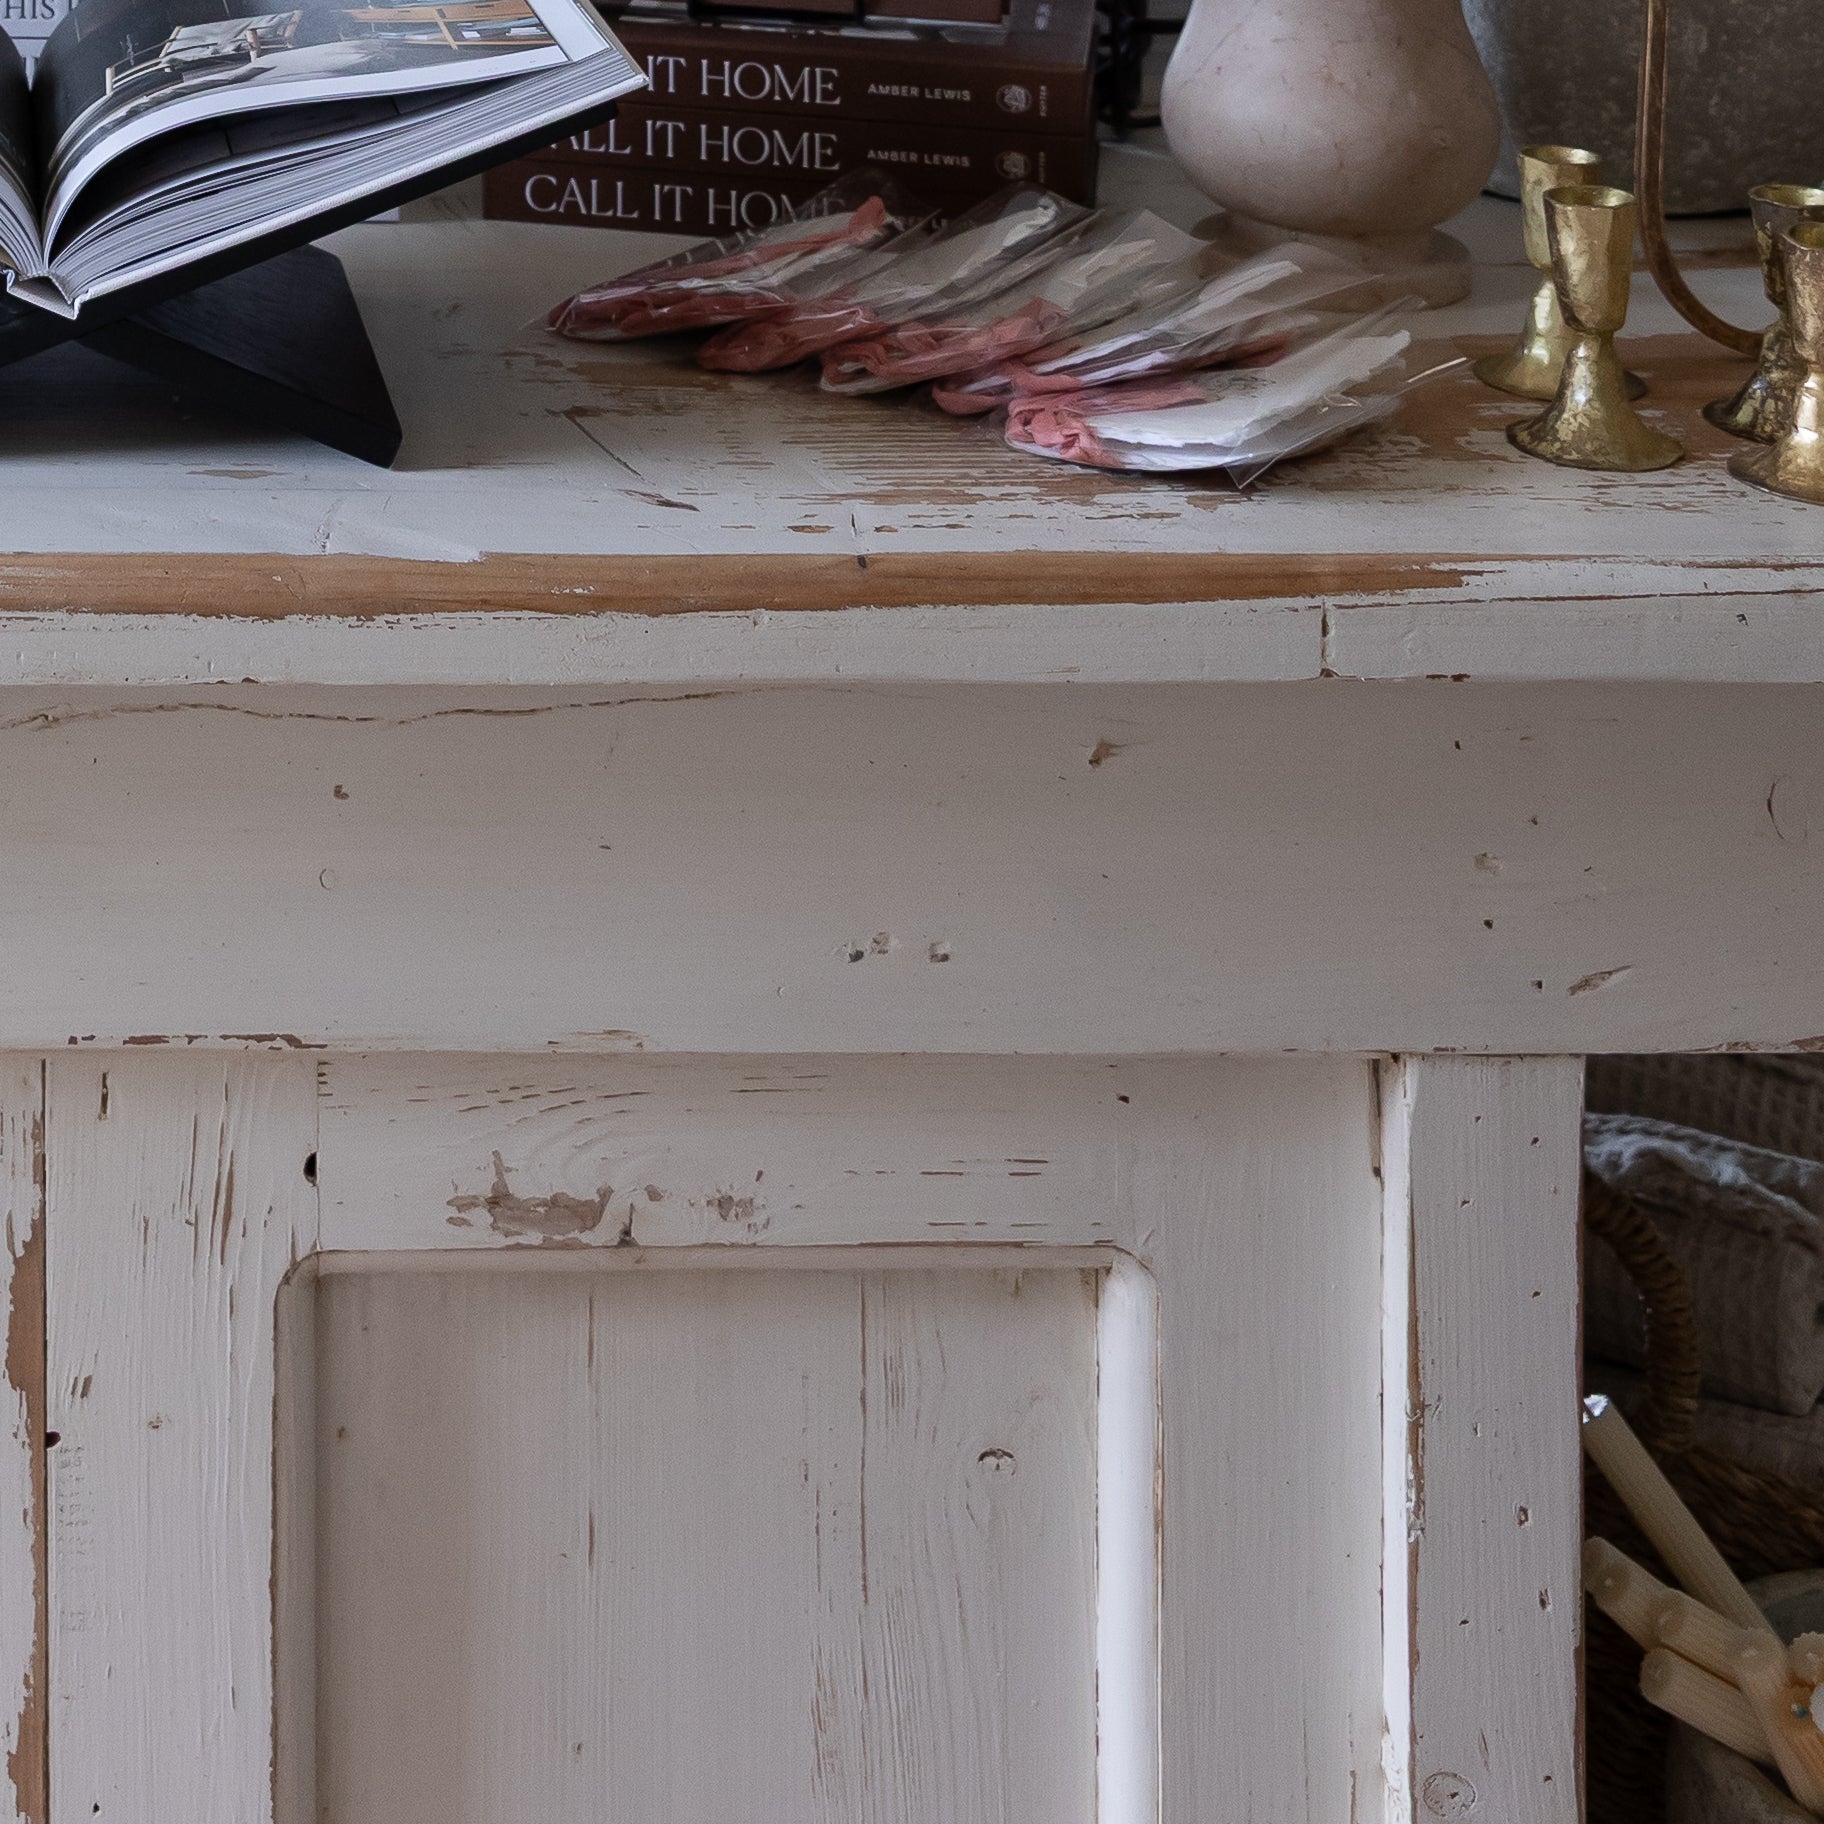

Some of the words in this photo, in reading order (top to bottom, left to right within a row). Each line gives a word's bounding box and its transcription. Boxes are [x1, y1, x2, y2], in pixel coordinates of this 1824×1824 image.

[647, 55, 687, 93] IT
[700, 59, 841, 105] HOME
[867, 83, 919, 98] AMBER
[925, 87, 972, 102] LEWIS
[645, 120, 685, 158] IT
[699, 123, 840, 171] HOME
[866, 149, 919, 164] AMBER
[924, 153, 971, 168] LEWIS
[525, 174, 639, 220] CALL
[653, 183, 693, 222] IT
